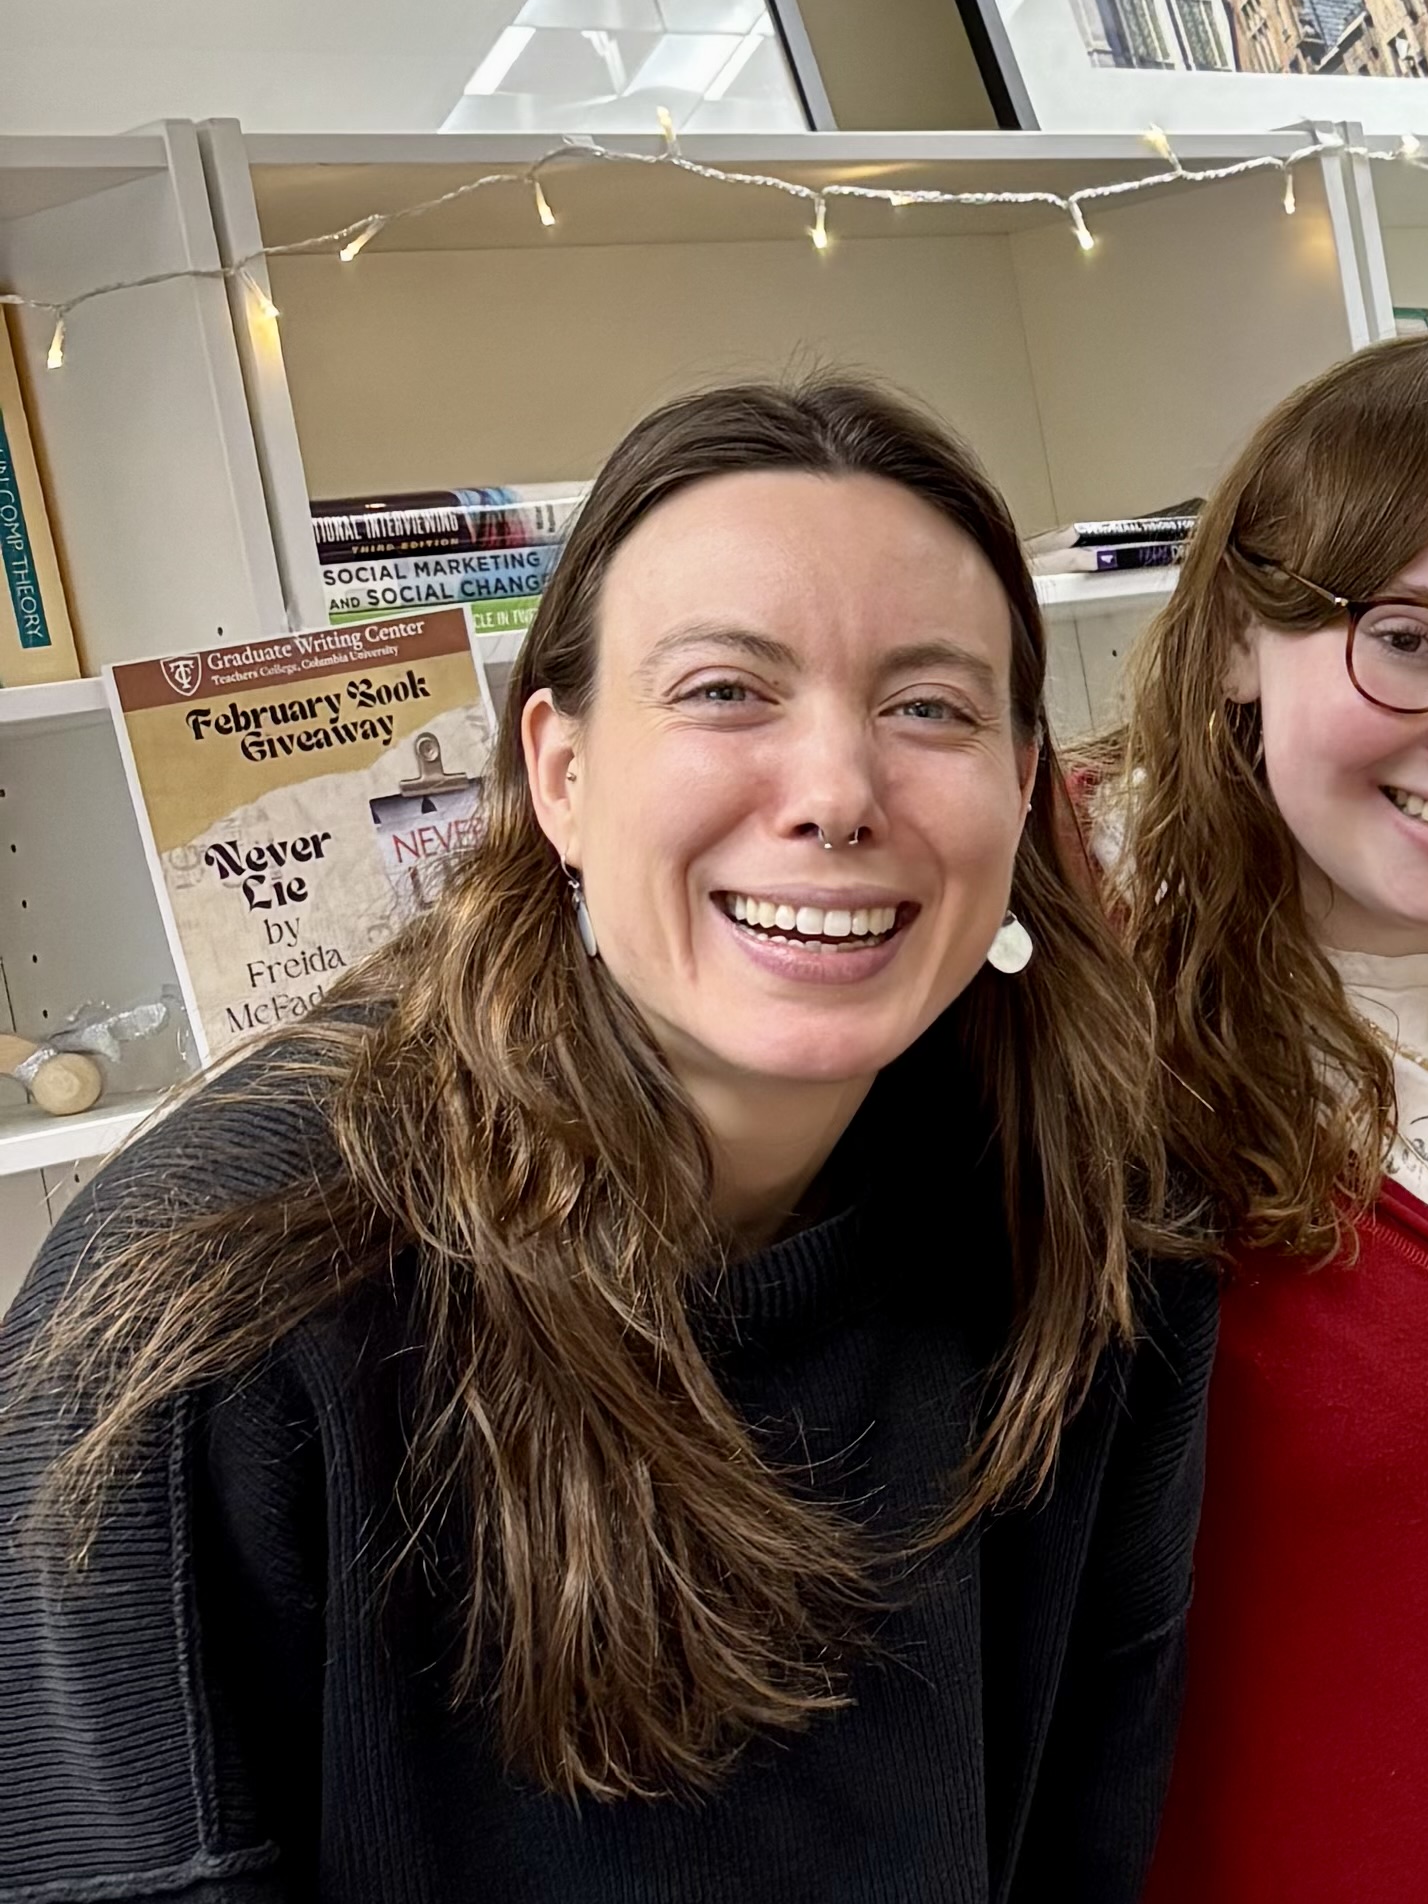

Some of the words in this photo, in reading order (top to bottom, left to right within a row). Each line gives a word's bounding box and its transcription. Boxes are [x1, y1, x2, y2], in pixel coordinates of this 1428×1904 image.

[0, 489, 25, 552] COMP
[364, 510, 460, 540] INTERVIEWING
[351, 543, 395, 555] THIRD
[400, 537, 460, 551] EDITION
[323, 566, 408, 586] SOCIAL
[413, 551, 541, 579] MARKETING
[12, 555, 44, 639] THEORY
[329, 595, 361, 611] AND
[367, 582, 454, 607] SOCIAL
[207, 641, 293, 671] Graduate
[294, 626, 364, 655] Writing
[364, 619, 425, 643] Center
[211, 670, 258, 686] Teachers
[259, 663, 301, 679] College,
[301, 651, 349, 670] Columbia
[350, 644, 399, 662] University
[186, 692, 343, 742] February
[346, 669, 431, 710] Book
[240, 712, 395, 762] Giveaway
[204, 831, 332, 881] Never
[242, 874, 309, 912] Lie
[264, 917, 301, 948] by
[247, 946, 348, 988] Freida
